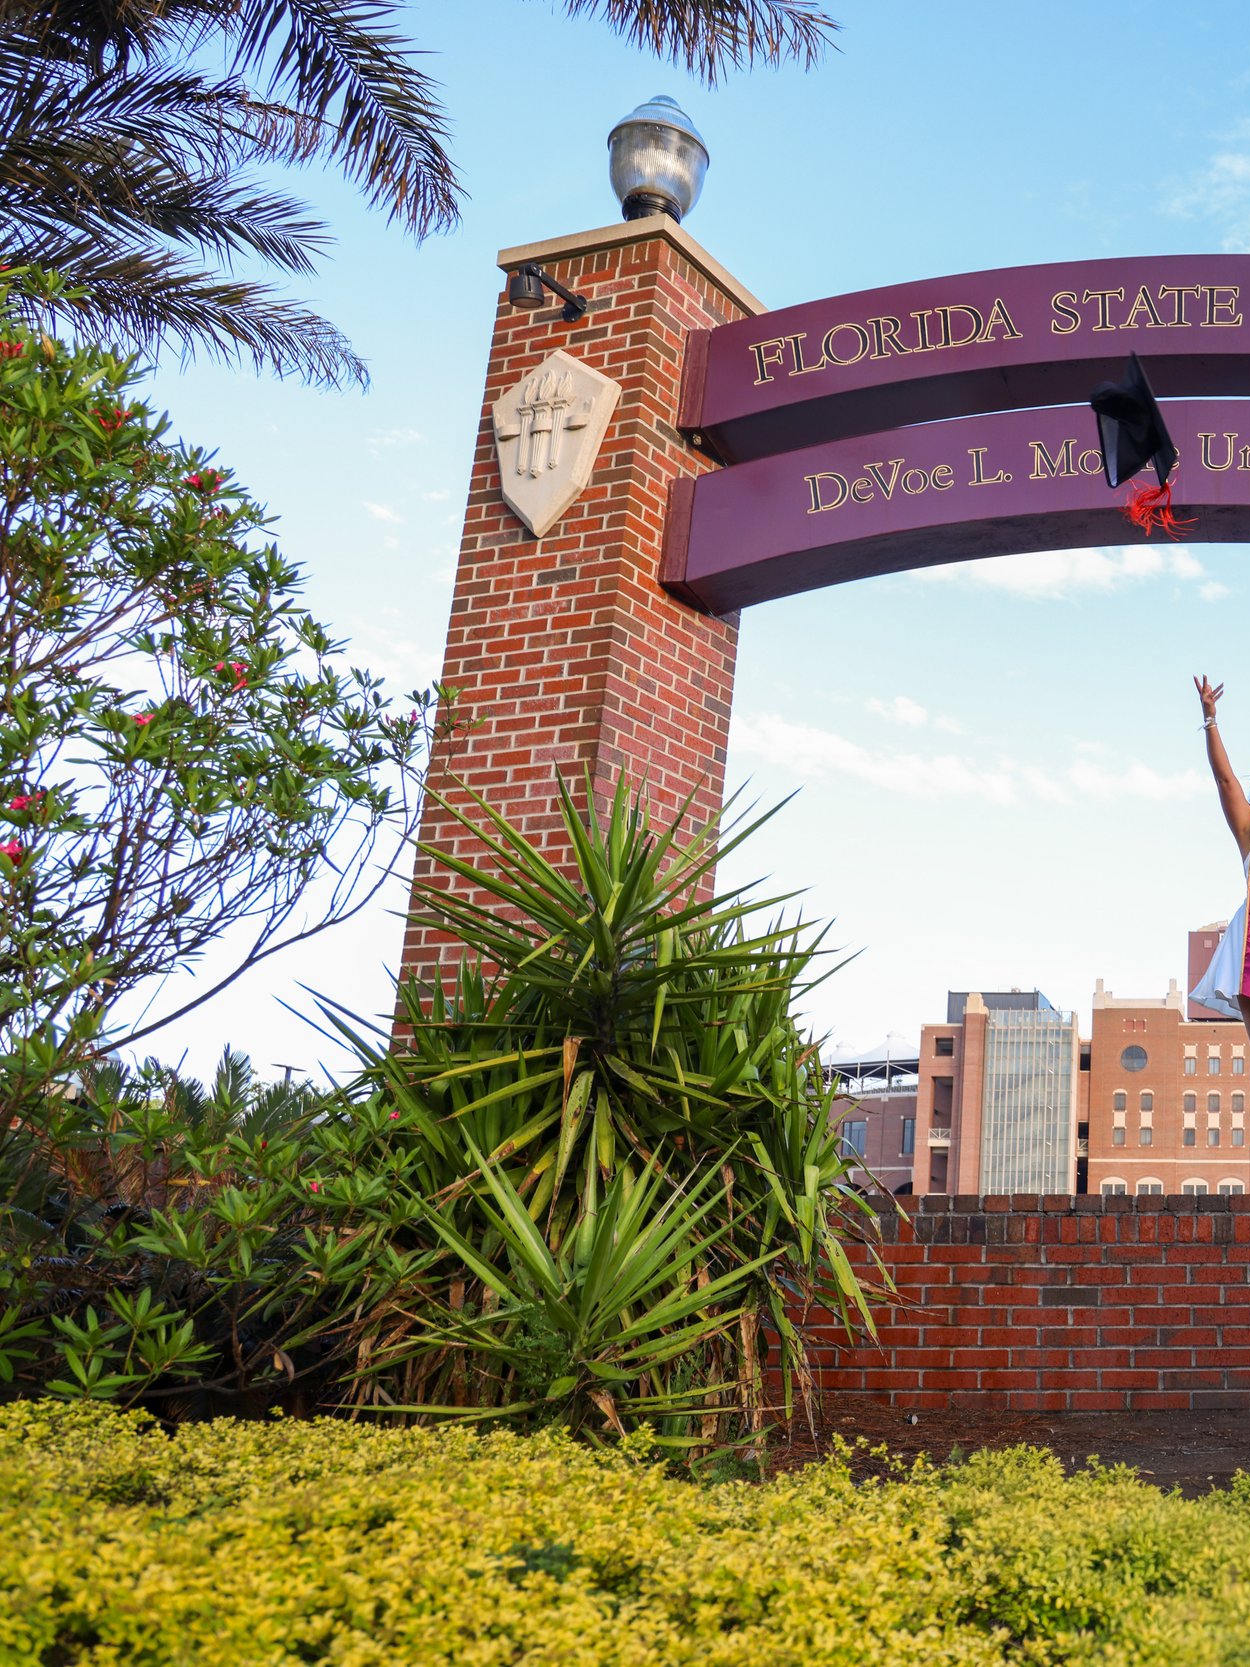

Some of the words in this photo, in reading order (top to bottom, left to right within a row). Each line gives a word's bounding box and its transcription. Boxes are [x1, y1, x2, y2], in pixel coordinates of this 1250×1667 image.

[749, 299, 1023, 385] FLORIDA
[1050, 285, 1243, 334] STATE
[804, 458, 954, 514] DeVoe
[968, 447, 1013, 486] L.
